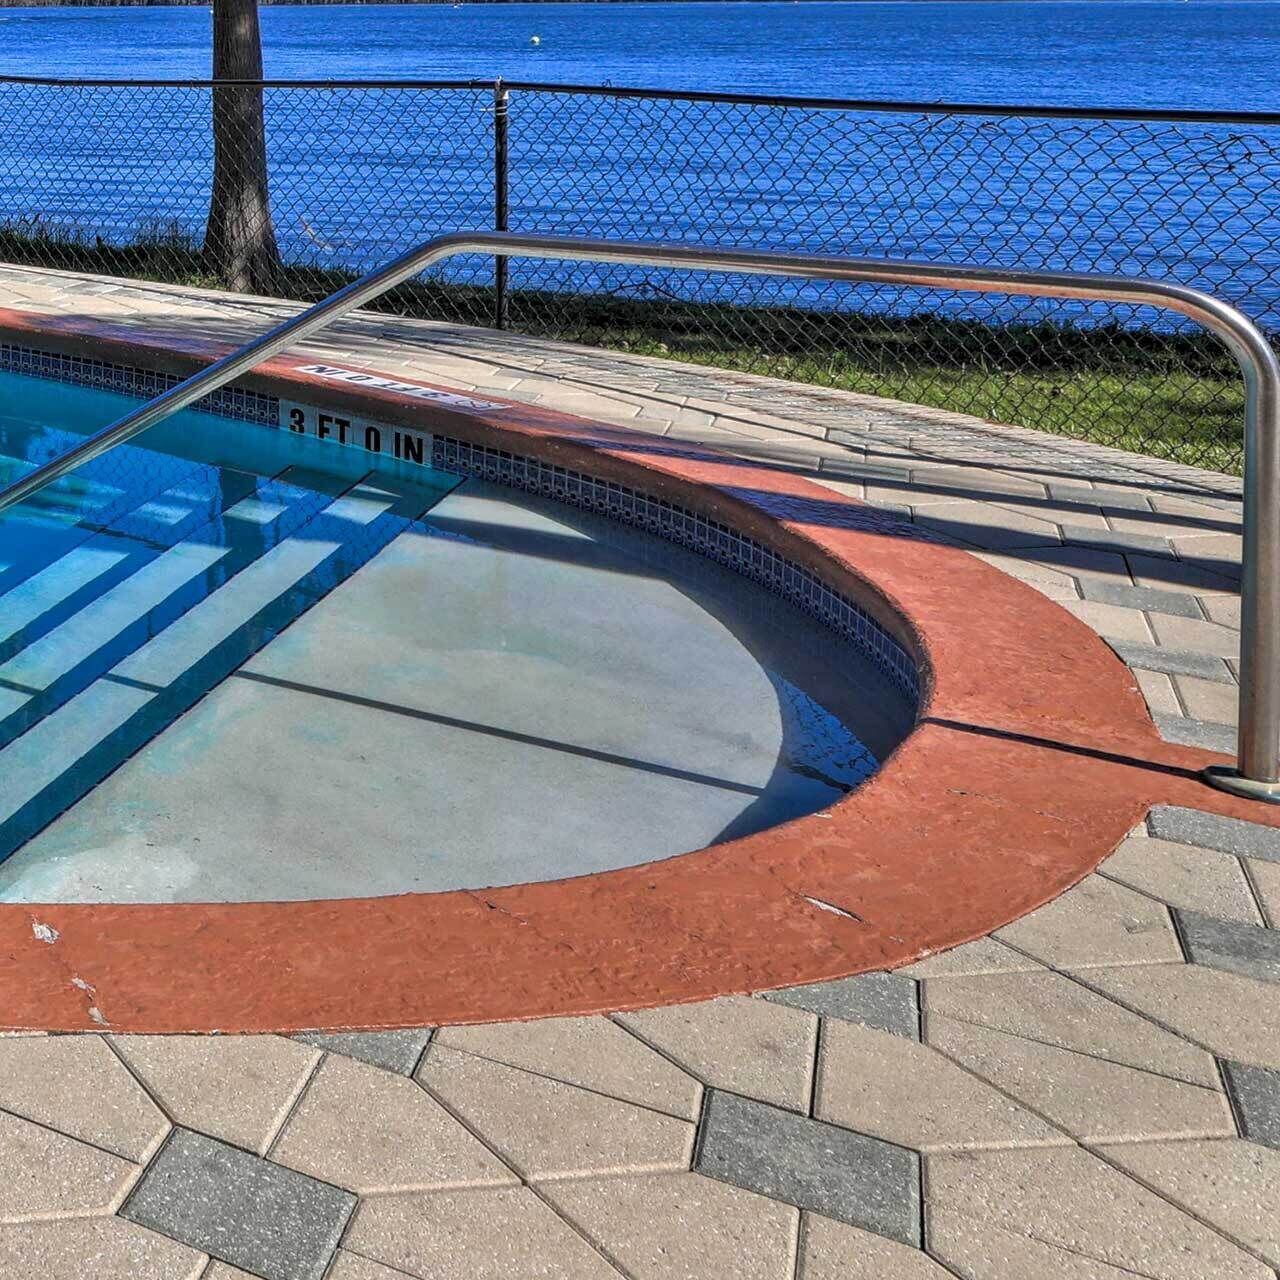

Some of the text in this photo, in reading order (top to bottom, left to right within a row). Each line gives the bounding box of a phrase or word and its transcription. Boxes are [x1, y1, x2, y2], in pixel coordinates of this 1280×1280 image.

[290, 408, 423, 464] 3 FT 0 IN
